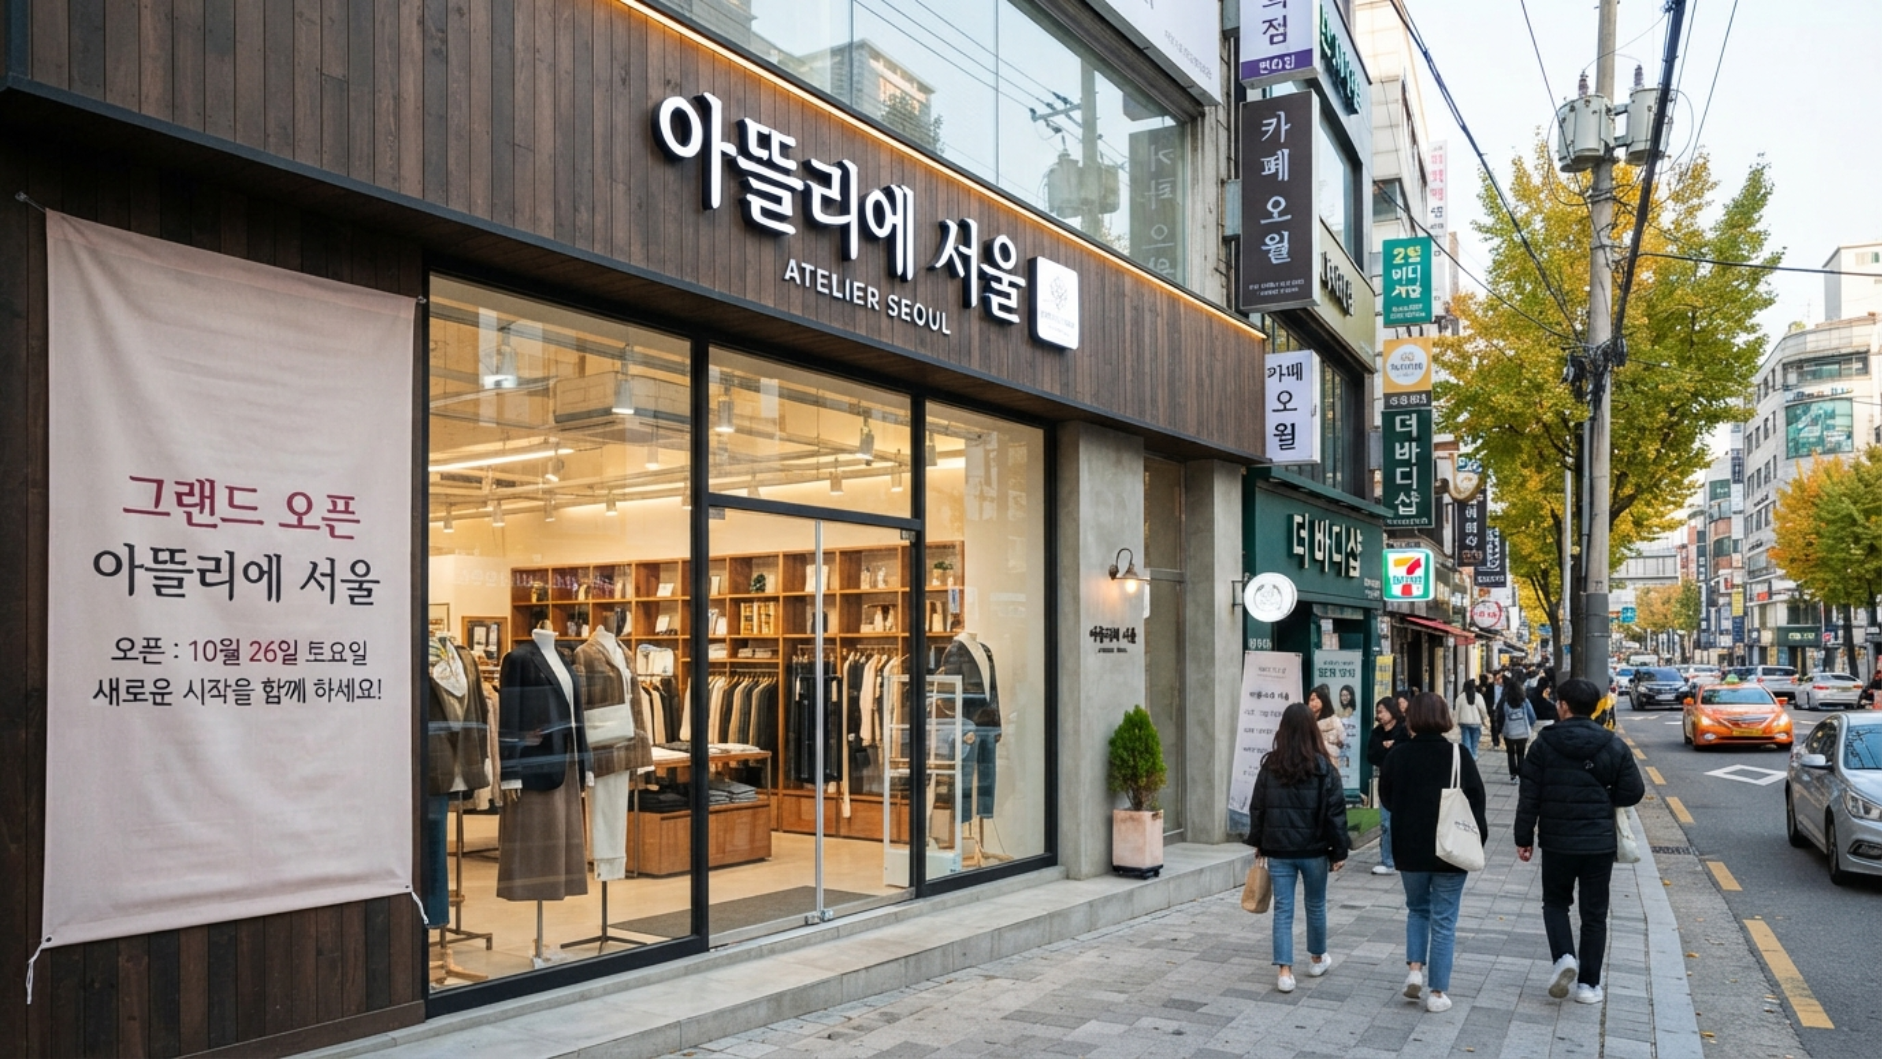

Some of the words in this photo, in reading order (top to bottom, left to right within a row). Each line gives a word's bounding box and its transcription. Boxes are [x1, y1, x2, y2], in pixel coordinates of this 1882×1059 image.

[655, 91, 915, 282] 아뜰리에
[929, 217, 1027, 325] 서울
[1259, 195, 1292, 266] 오월
[783, 258, 880, 312] ATELIER
[886, 294, 952, 336] SEOUL
[122, 475, 265, 530] 그랜드
[278, 491, 361, 541] 오픈
[92, 542, 282, 604] 아뜰리에
[299, 556, 381, 606] 서울
[110, 636, 166, 665] 오픈
[188, 637, 241, 667] 10월
[248, 639, 298, 666] 26일
[304, 640, 368, 666] 토요일
[92, 676, 174, 707] 새로운
[182, 677, 256, 707] 시작을
[260, 676, 307, 706] 함께
[312, 677, 382, 703] 하세요!
